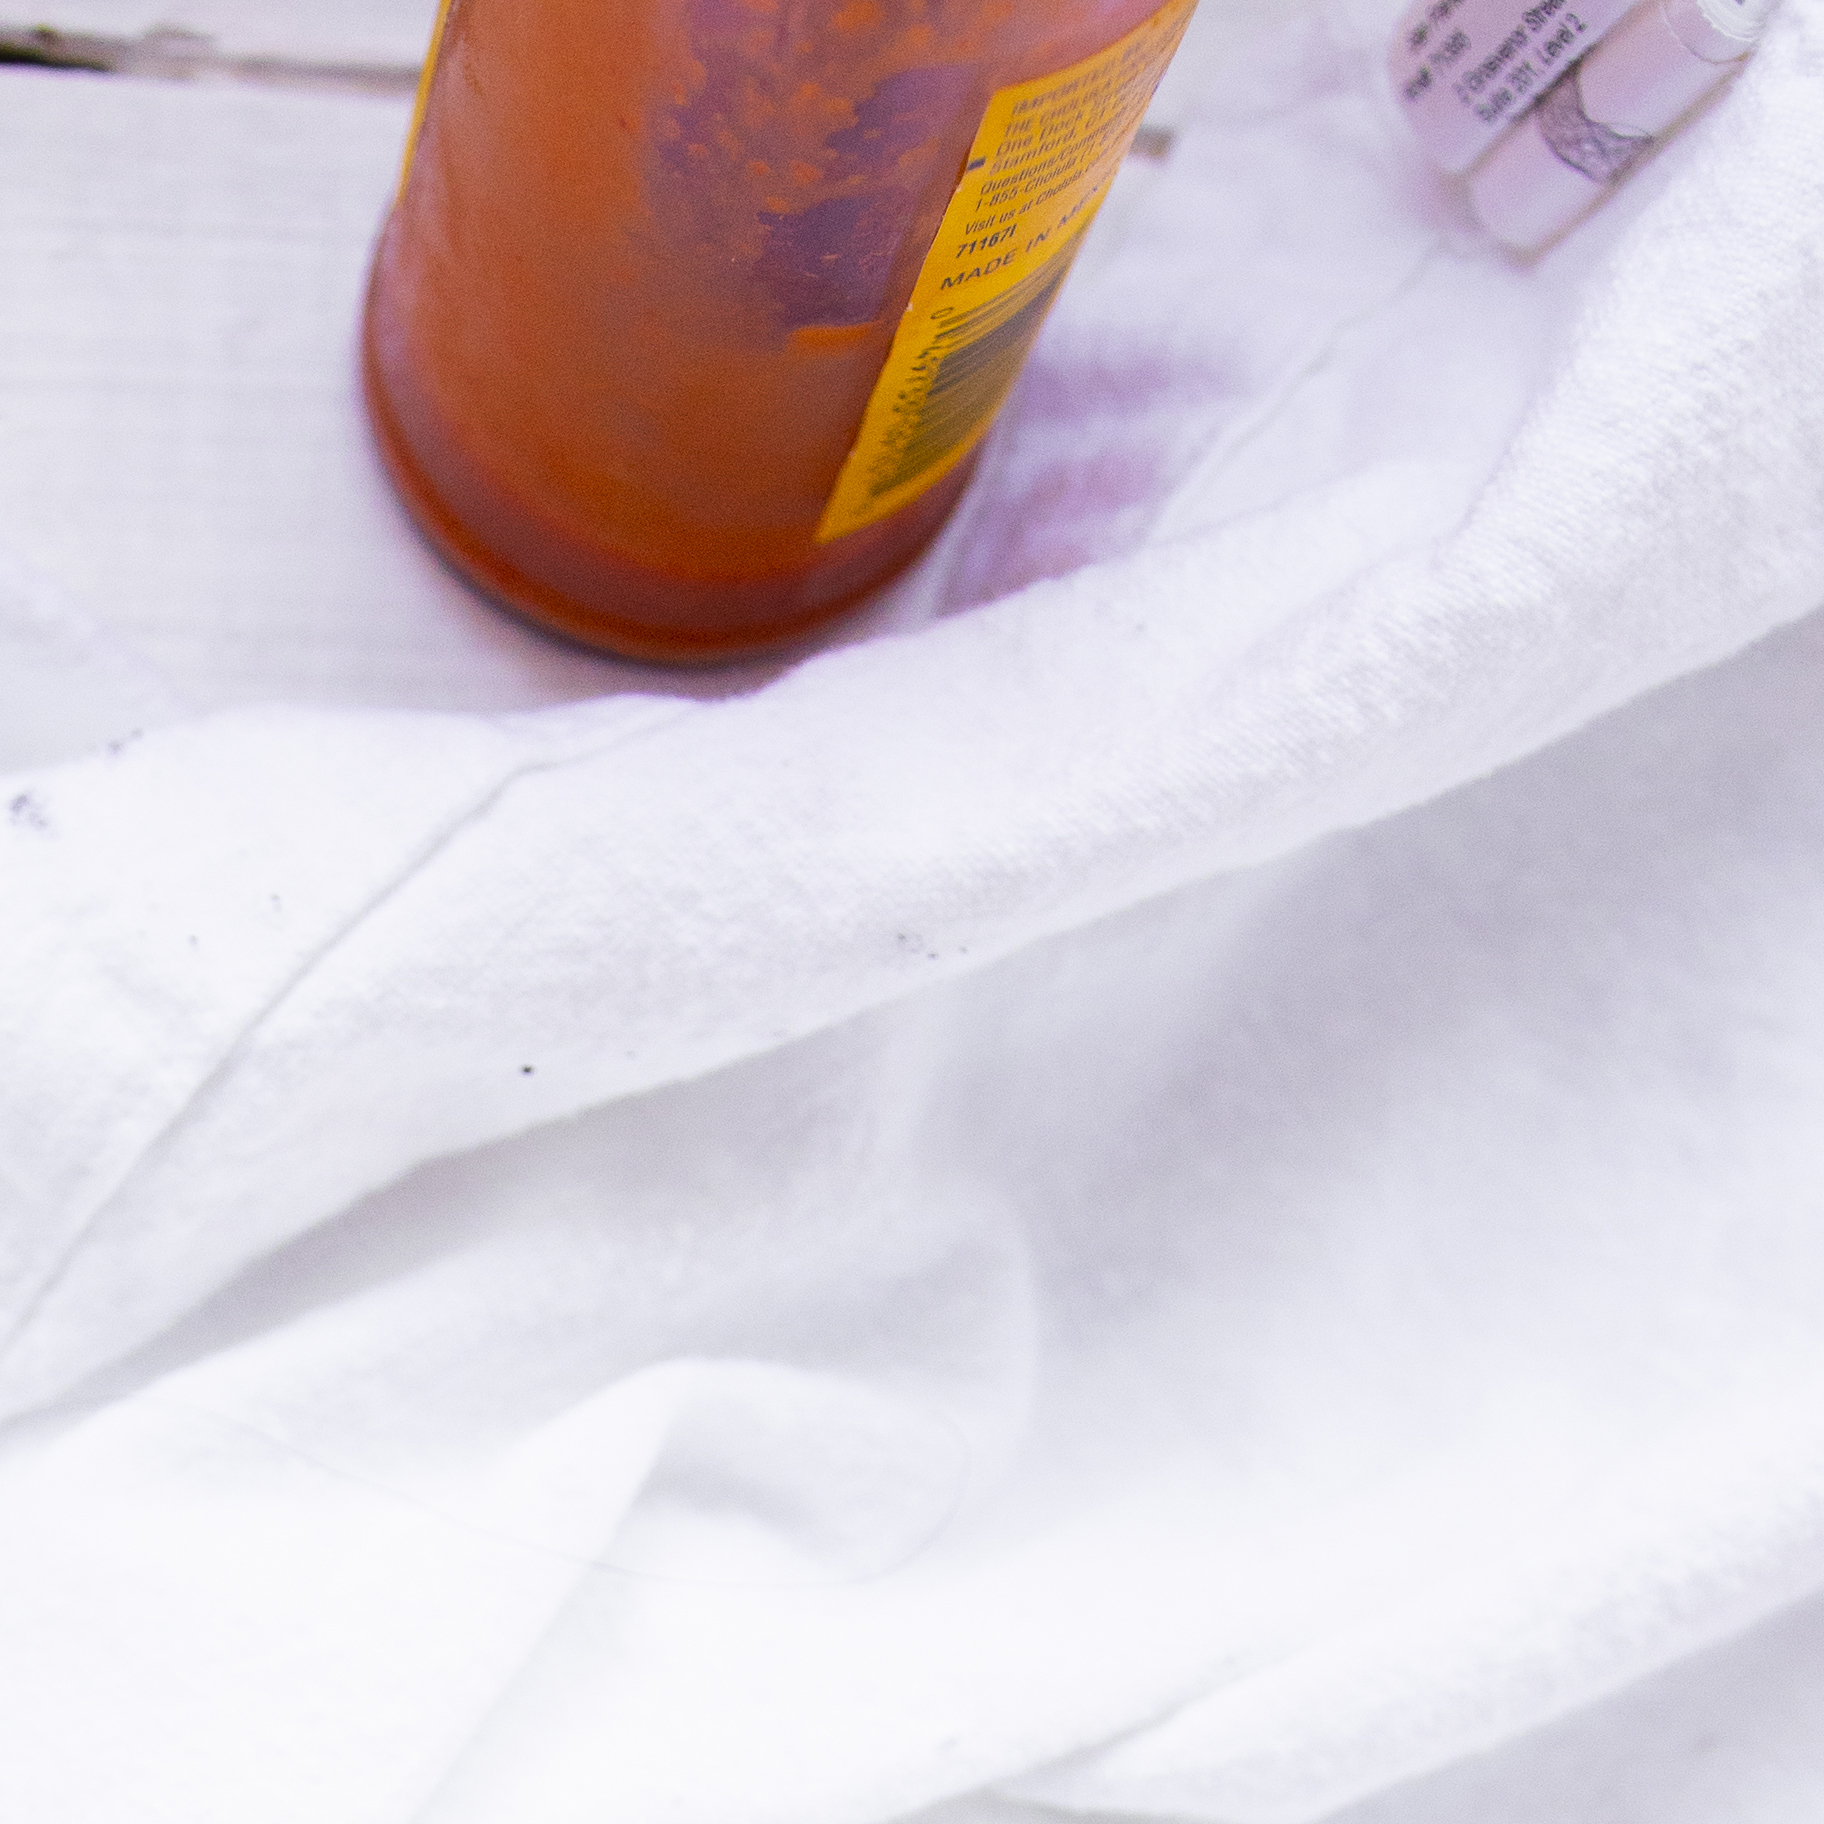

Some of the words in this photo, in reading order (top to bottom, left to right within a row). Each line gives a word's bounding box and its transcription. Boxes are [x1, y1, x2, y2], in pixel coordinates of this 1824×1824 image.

[1522, 0, 1566, 32] Stree
[1535, 21, 1575, 67] Level
[1565, 12, 1588, 33] 2
[989, 125, 1079, 175] Stamford,
[995, 133, 1034, 157] One
[1039, 107, 1084, 141] Dock
[1003, 116, 1033, 138] THE
[964, 213, 997, 236] Visit
[999, 209, 1017, 224] us
[1019, 199, 1033, 214] at
[939, 247, 1018, 291] MADE
[1025, 226, 1051, 253] IN
